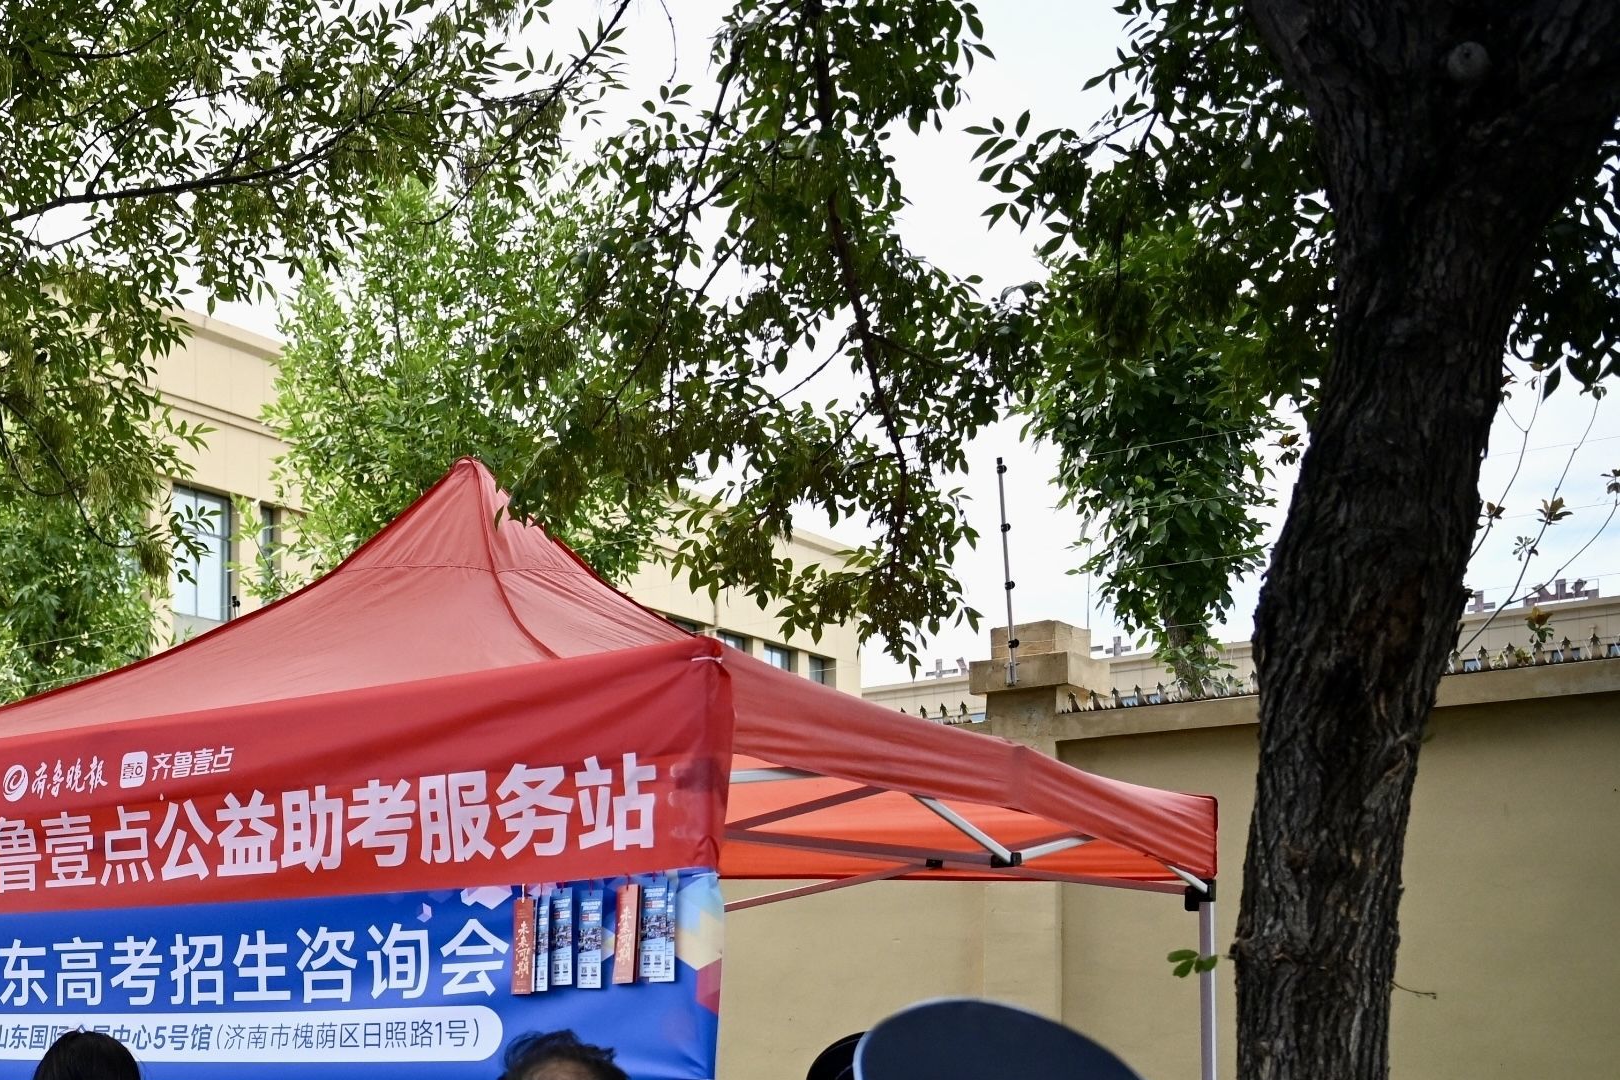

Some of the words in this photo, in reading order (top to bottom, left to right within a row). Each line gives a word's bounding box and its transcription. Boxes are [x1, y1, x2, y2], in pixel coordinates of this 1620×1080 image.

[152, 746, 234, 781] 齐鲁壹点
[515, 920, 530, 979] 未来可期
